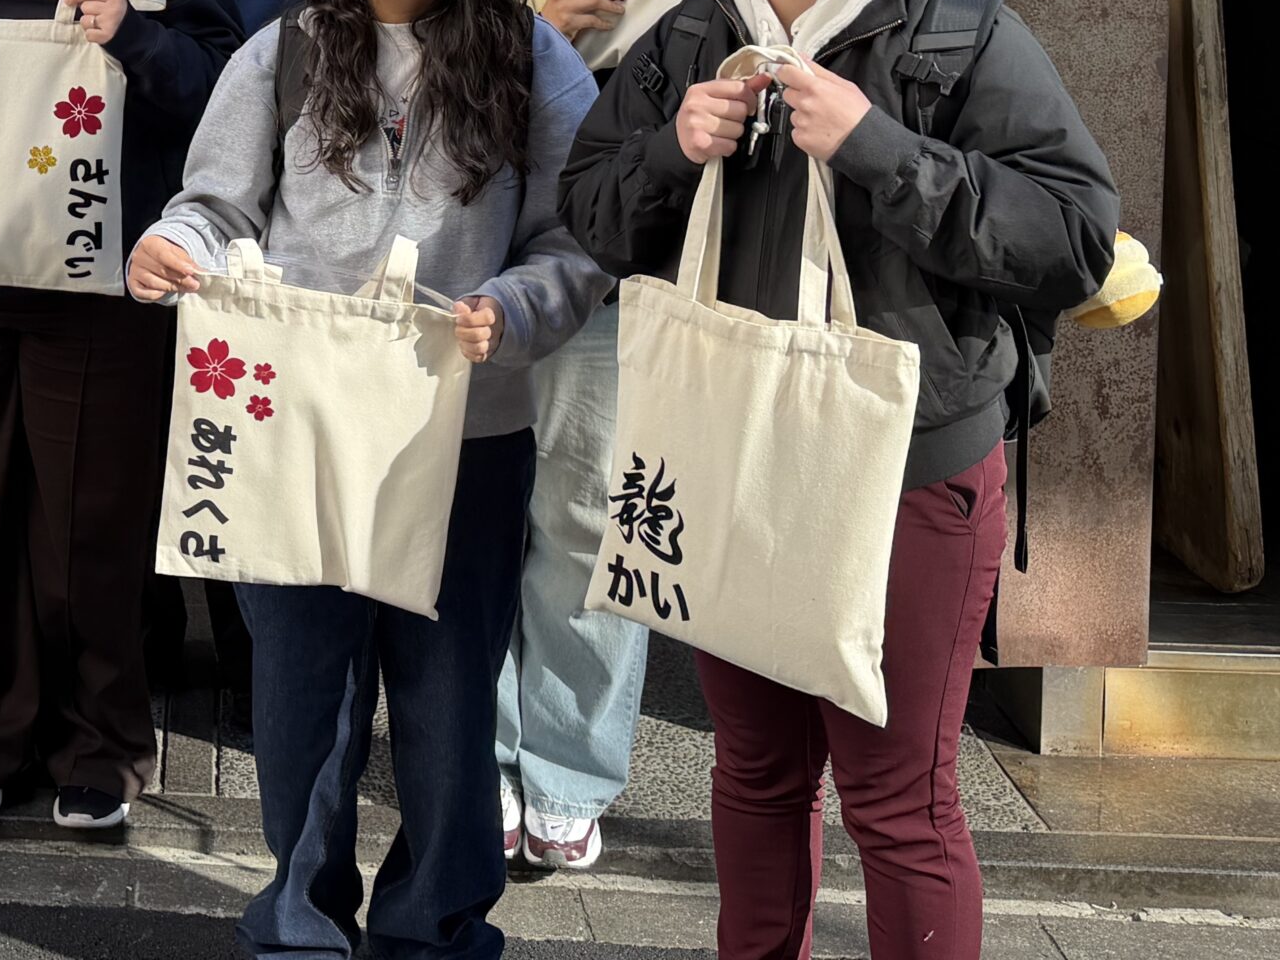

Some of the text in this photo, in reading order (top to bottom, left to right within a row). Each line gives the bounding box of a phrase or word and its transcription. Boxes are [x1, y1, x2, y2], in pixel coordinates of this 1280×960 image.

[180, 418, 238, 563] あれくさ
[608, 451, 685, 565] 龍
[607, 553, 690, 622] かい
